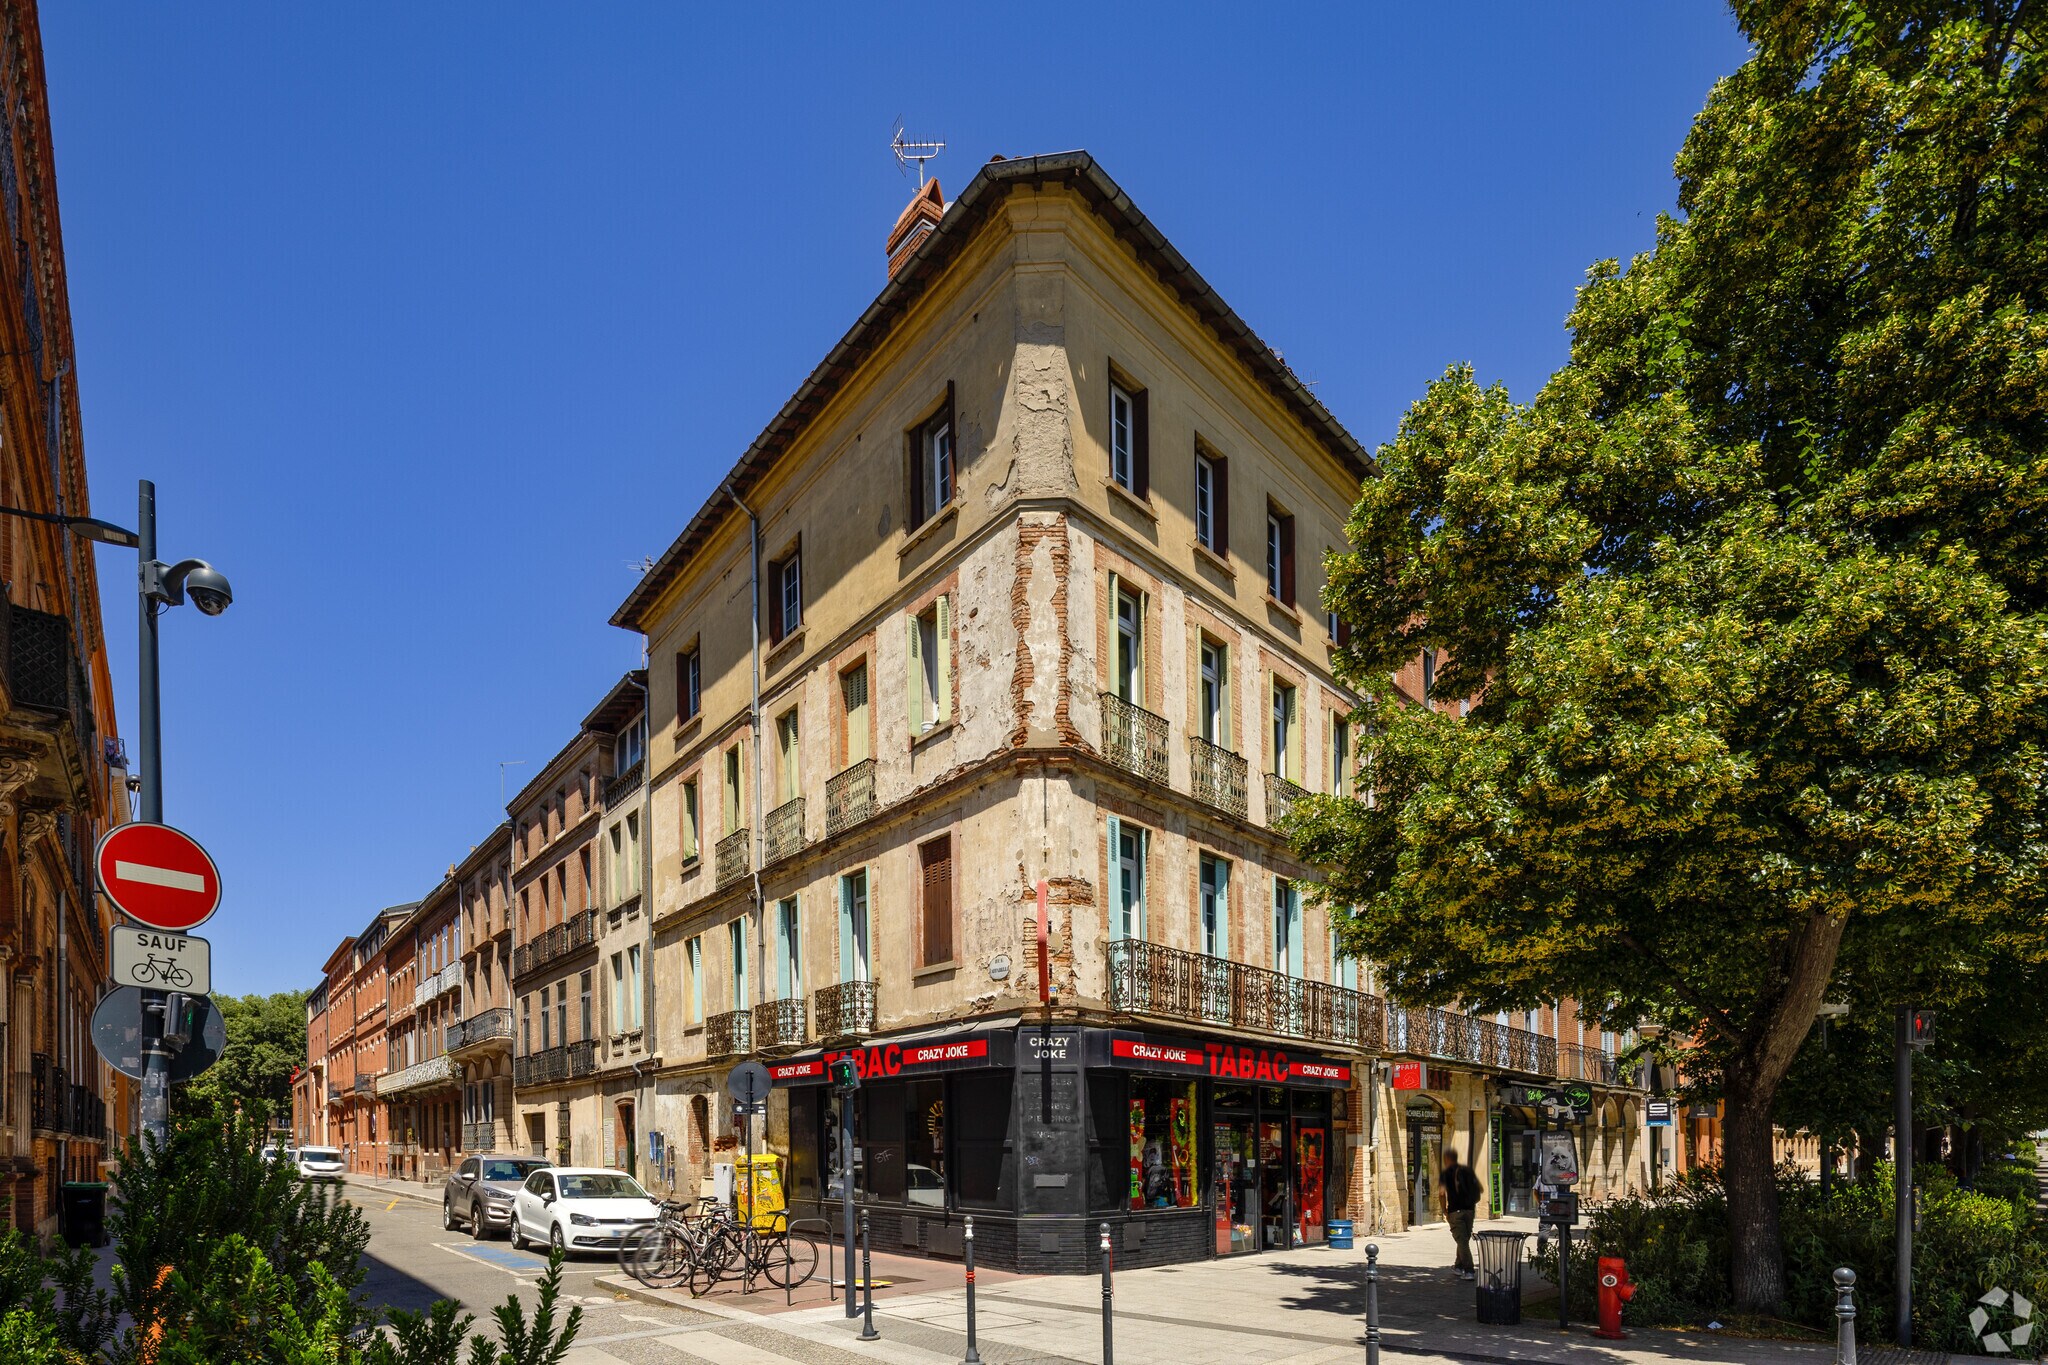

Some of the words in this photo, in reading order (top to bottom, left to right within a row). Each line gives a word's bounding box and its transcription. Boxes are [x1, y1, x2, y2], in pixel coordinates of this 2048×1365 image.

[137, 933, 187, 952] SAUF
[1029, 1037, 1070, 1047] CRAZY
[918, 1047, 944, 1061] CRAZY
[945, 1045, 968, 1058] JOKE
[1034, 1049, 1067, 1059] JOKE
[1132, 1045, 1162, 1059] CRAZY
[1163, 1048, 1187, 1061] JOKE
[823, 1043, 901, 1082] TBAC
[1205, 1043, 1289, 1082] TABAC
[777, 1066, 796, 1077] CRAZY
[796, 1065, 811, 1075] JOKE
[1302, 1065, 1322, 1076] CRAZY
[1322, 1067, 1339, 1078] JOKE
